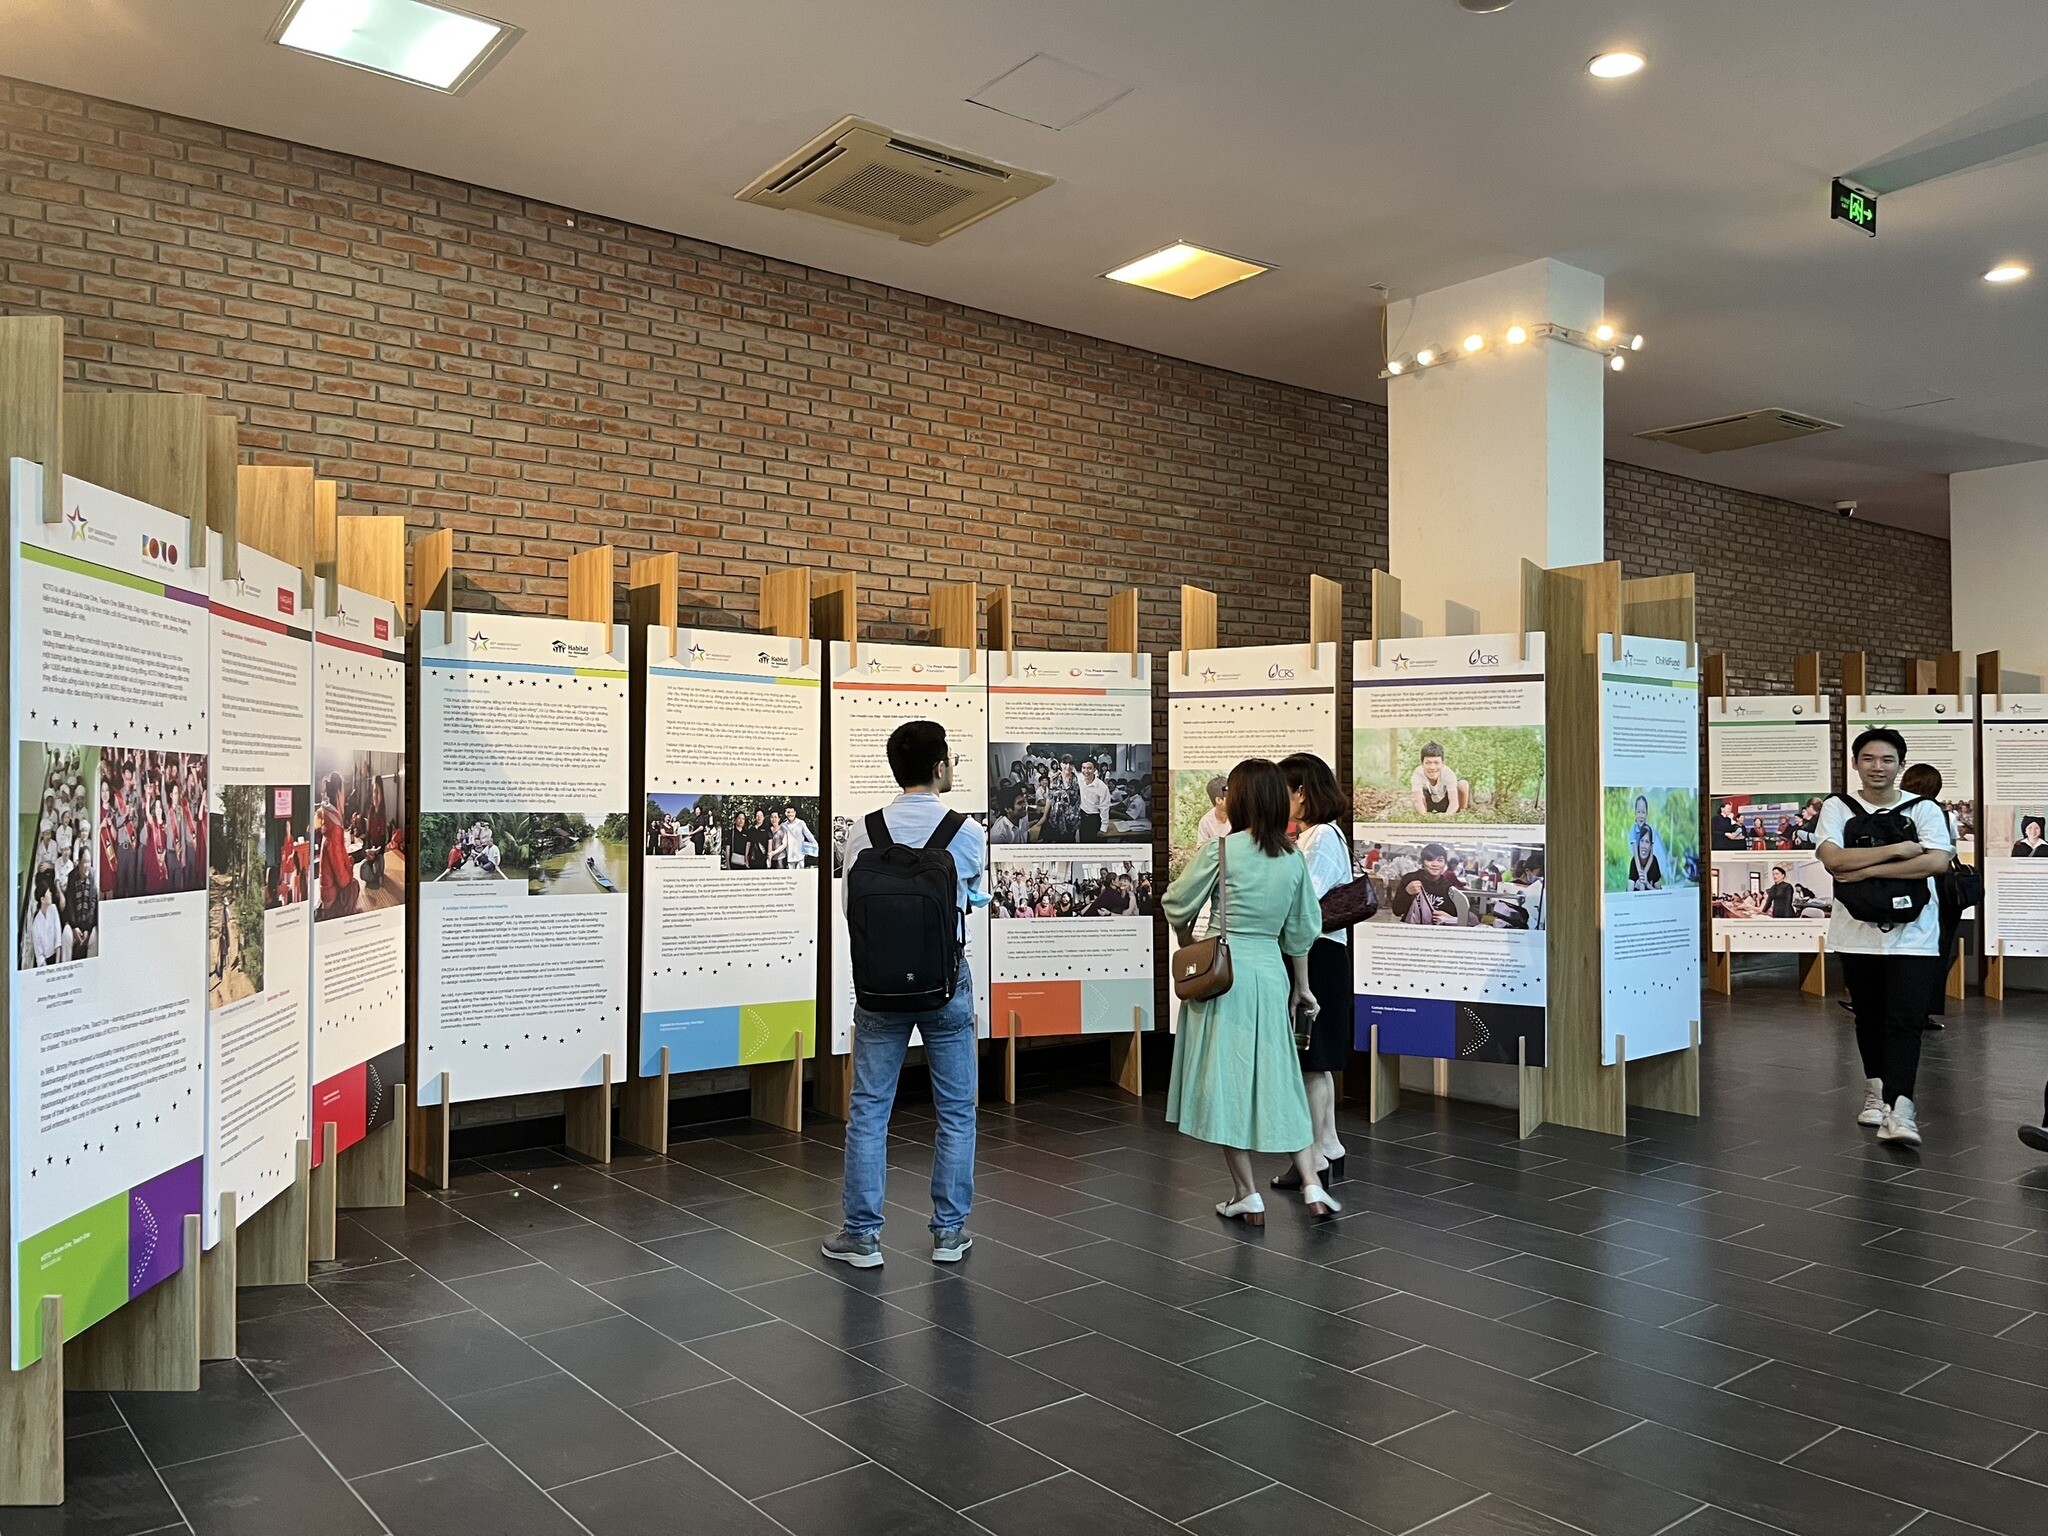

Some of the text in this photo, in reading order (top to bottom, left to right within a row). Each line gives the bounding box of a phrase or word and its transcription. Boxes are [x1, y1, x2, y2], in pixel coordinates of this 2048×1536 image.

[1480, 654, 1498, 664] CRS
[1655, 656, 1680, 666] ChildFund
[1278, 669, 1294, 678] CRS
